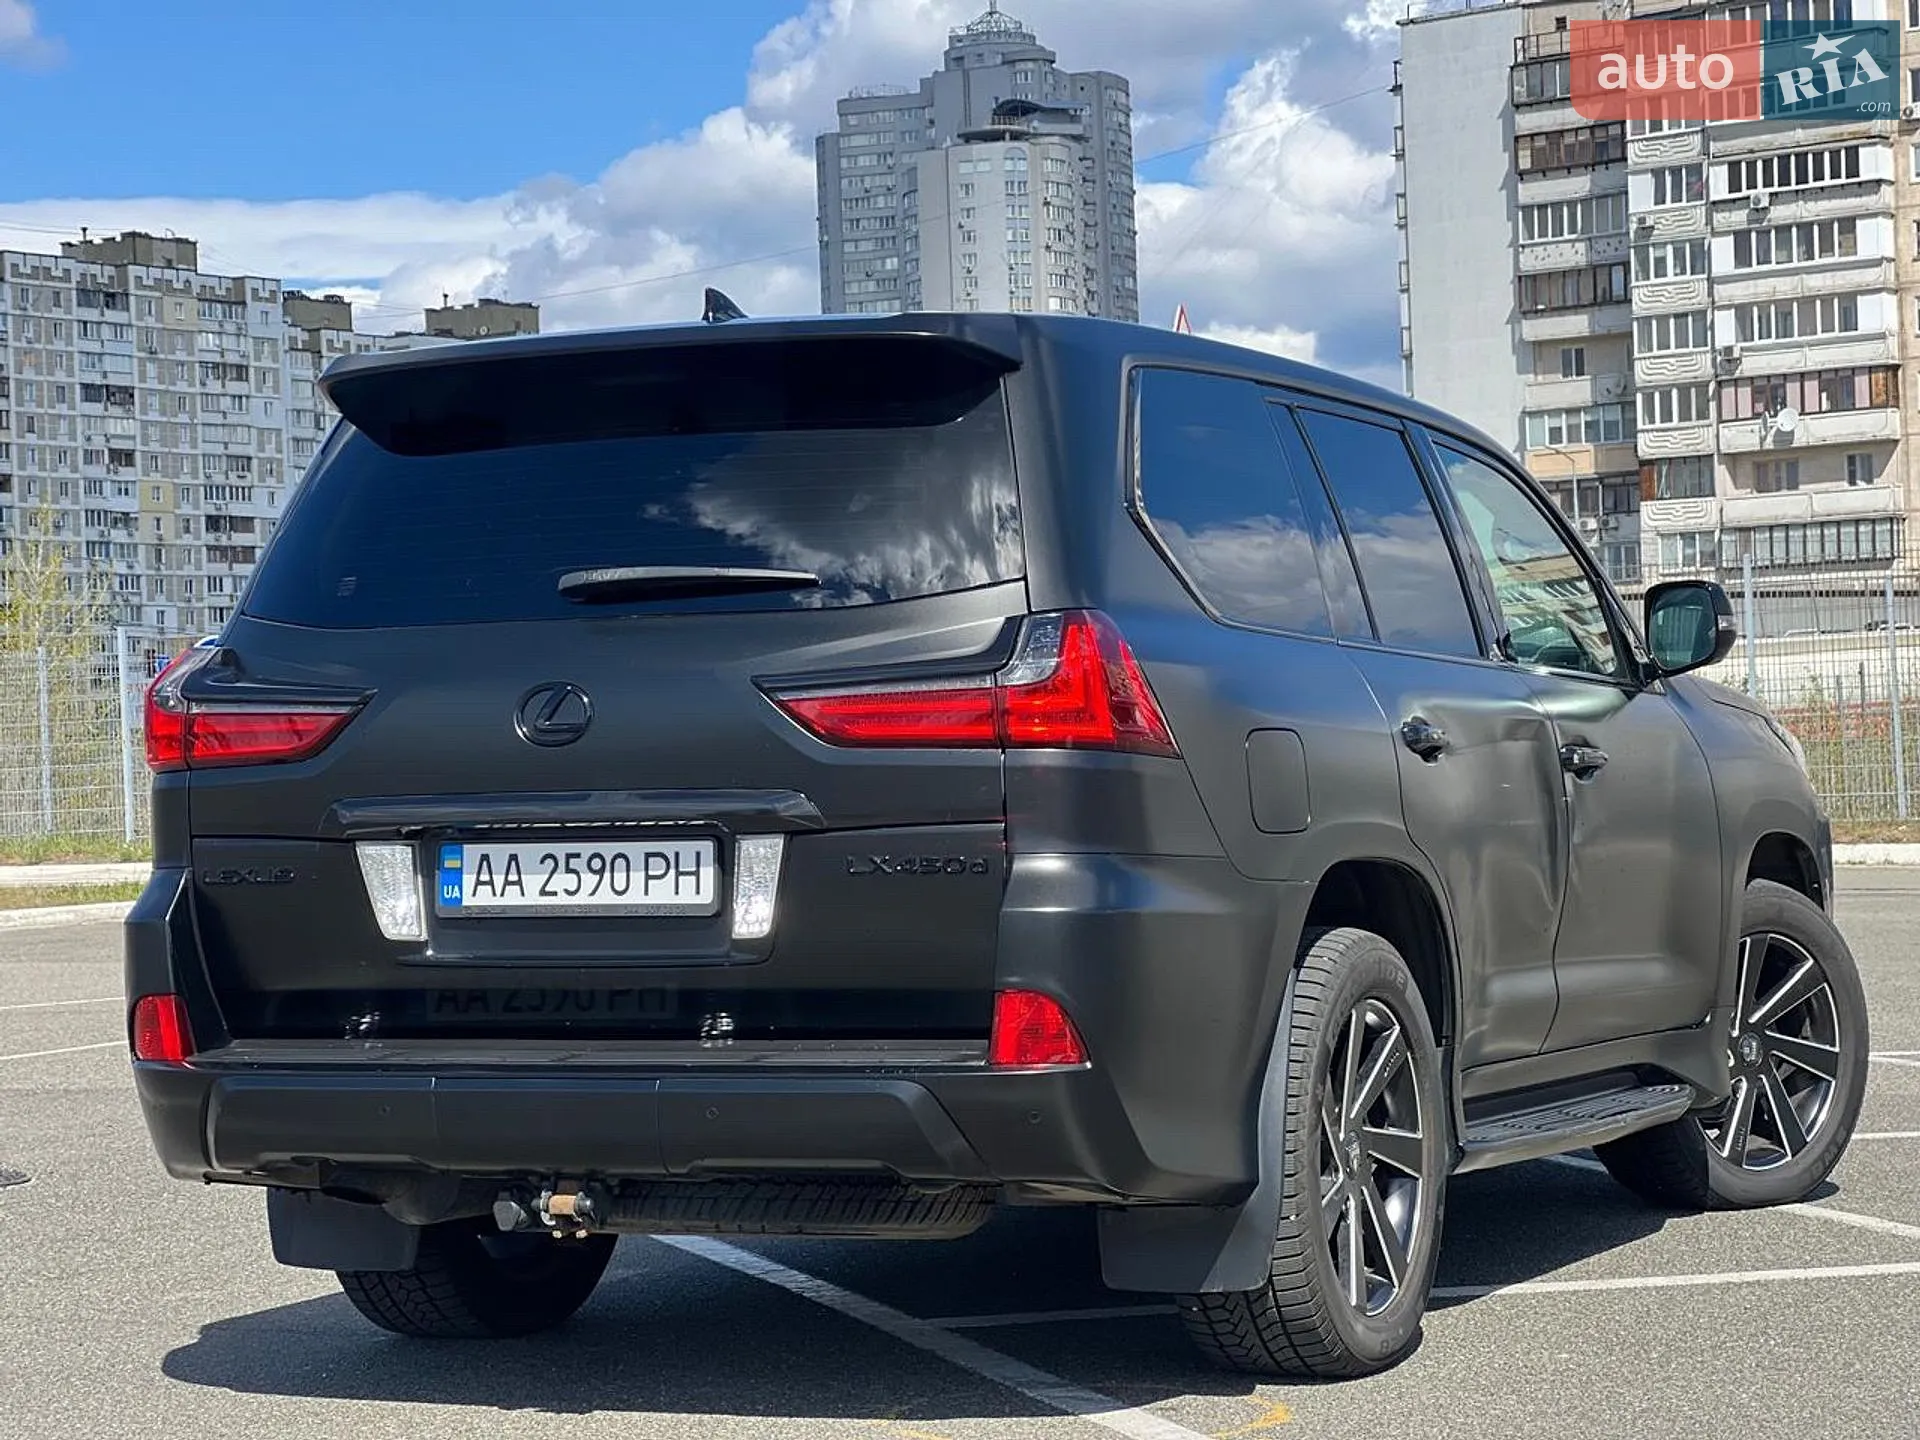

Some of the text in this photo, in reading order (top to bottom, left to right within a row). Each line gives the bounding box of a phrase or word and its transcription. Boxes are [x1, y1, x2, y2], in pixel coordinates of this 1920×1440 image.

[203, 867, 295, 885] LEXUS
[472, 851, 701, 897] AA 2590 PH
[443, 885, 460, 899] UA
